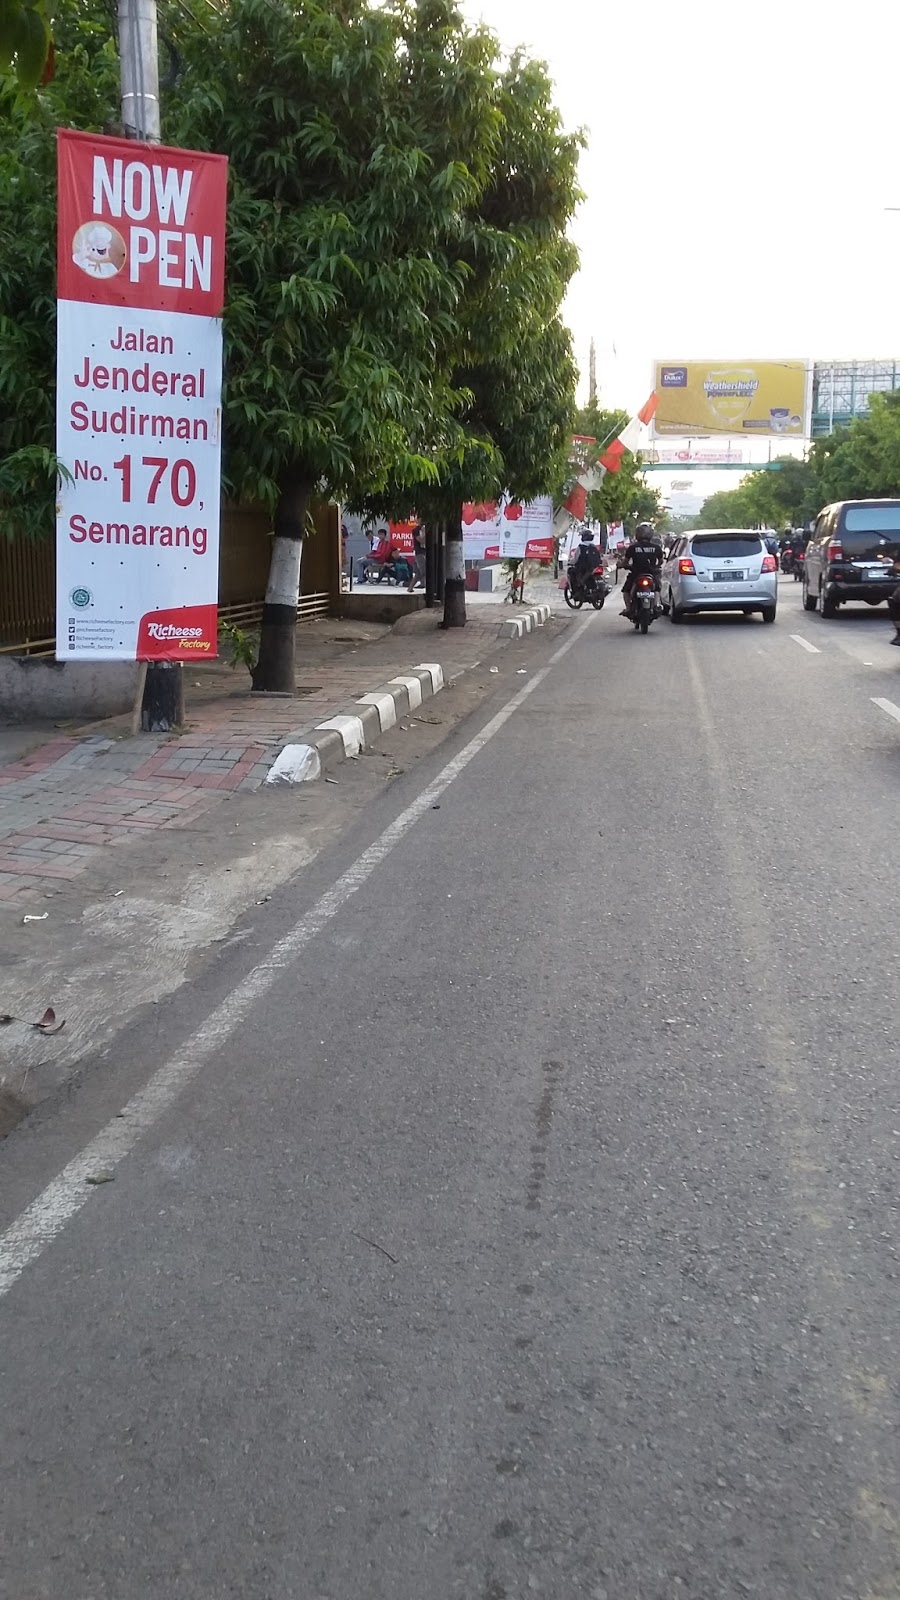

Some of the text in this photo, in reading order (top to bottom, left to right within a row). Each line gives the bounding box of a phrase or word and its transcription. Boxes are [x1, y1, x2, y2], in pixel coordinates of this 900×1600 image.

[93, 155, 193, 226] NOW
[110, 326, 174, 354] Jalan
[74, 356, 205, 398] Jenderal
[703, 379, 759, 390] Weathershield
[70, 401, 208, 440] Sudirman
[74, 454, 204, 511] No. 170,
[69, 514, 208, 555] Semarang
[147, 622, 203, 640] Richeese
[179, 638, 211, 651] Factory
